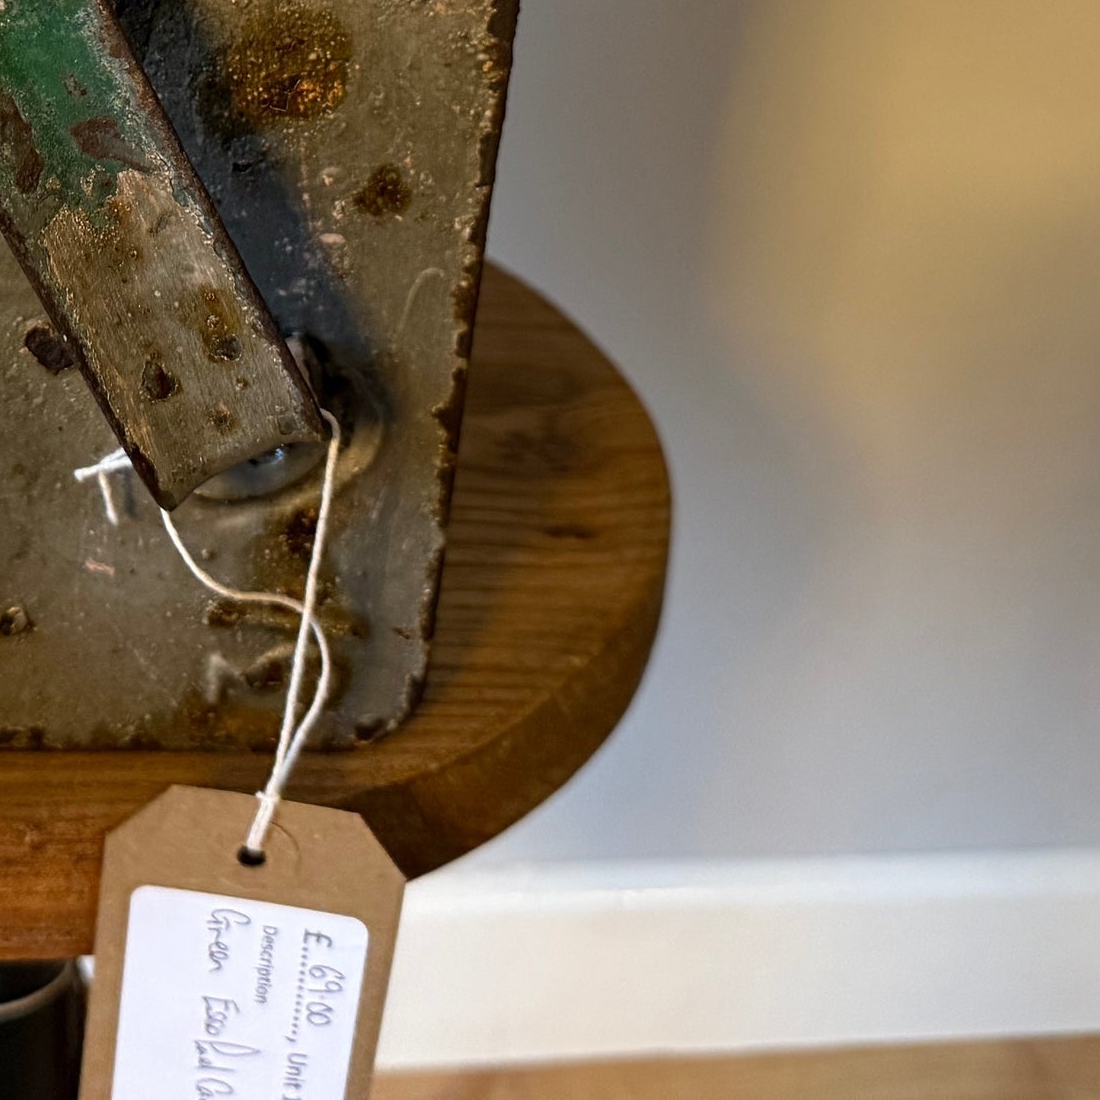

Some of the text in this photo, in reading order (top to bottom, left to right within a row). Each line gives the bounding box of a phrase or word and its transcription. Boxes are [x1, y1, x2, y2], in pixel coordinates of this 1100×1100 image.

[206, 908, 251, 972] Green
[254, 924, 278, 1004] Description
[202, 995, 241, 1035] Esso
[196, 1077, 234, 1100] Ca
[283, 1052, 307, 1090] Unit
